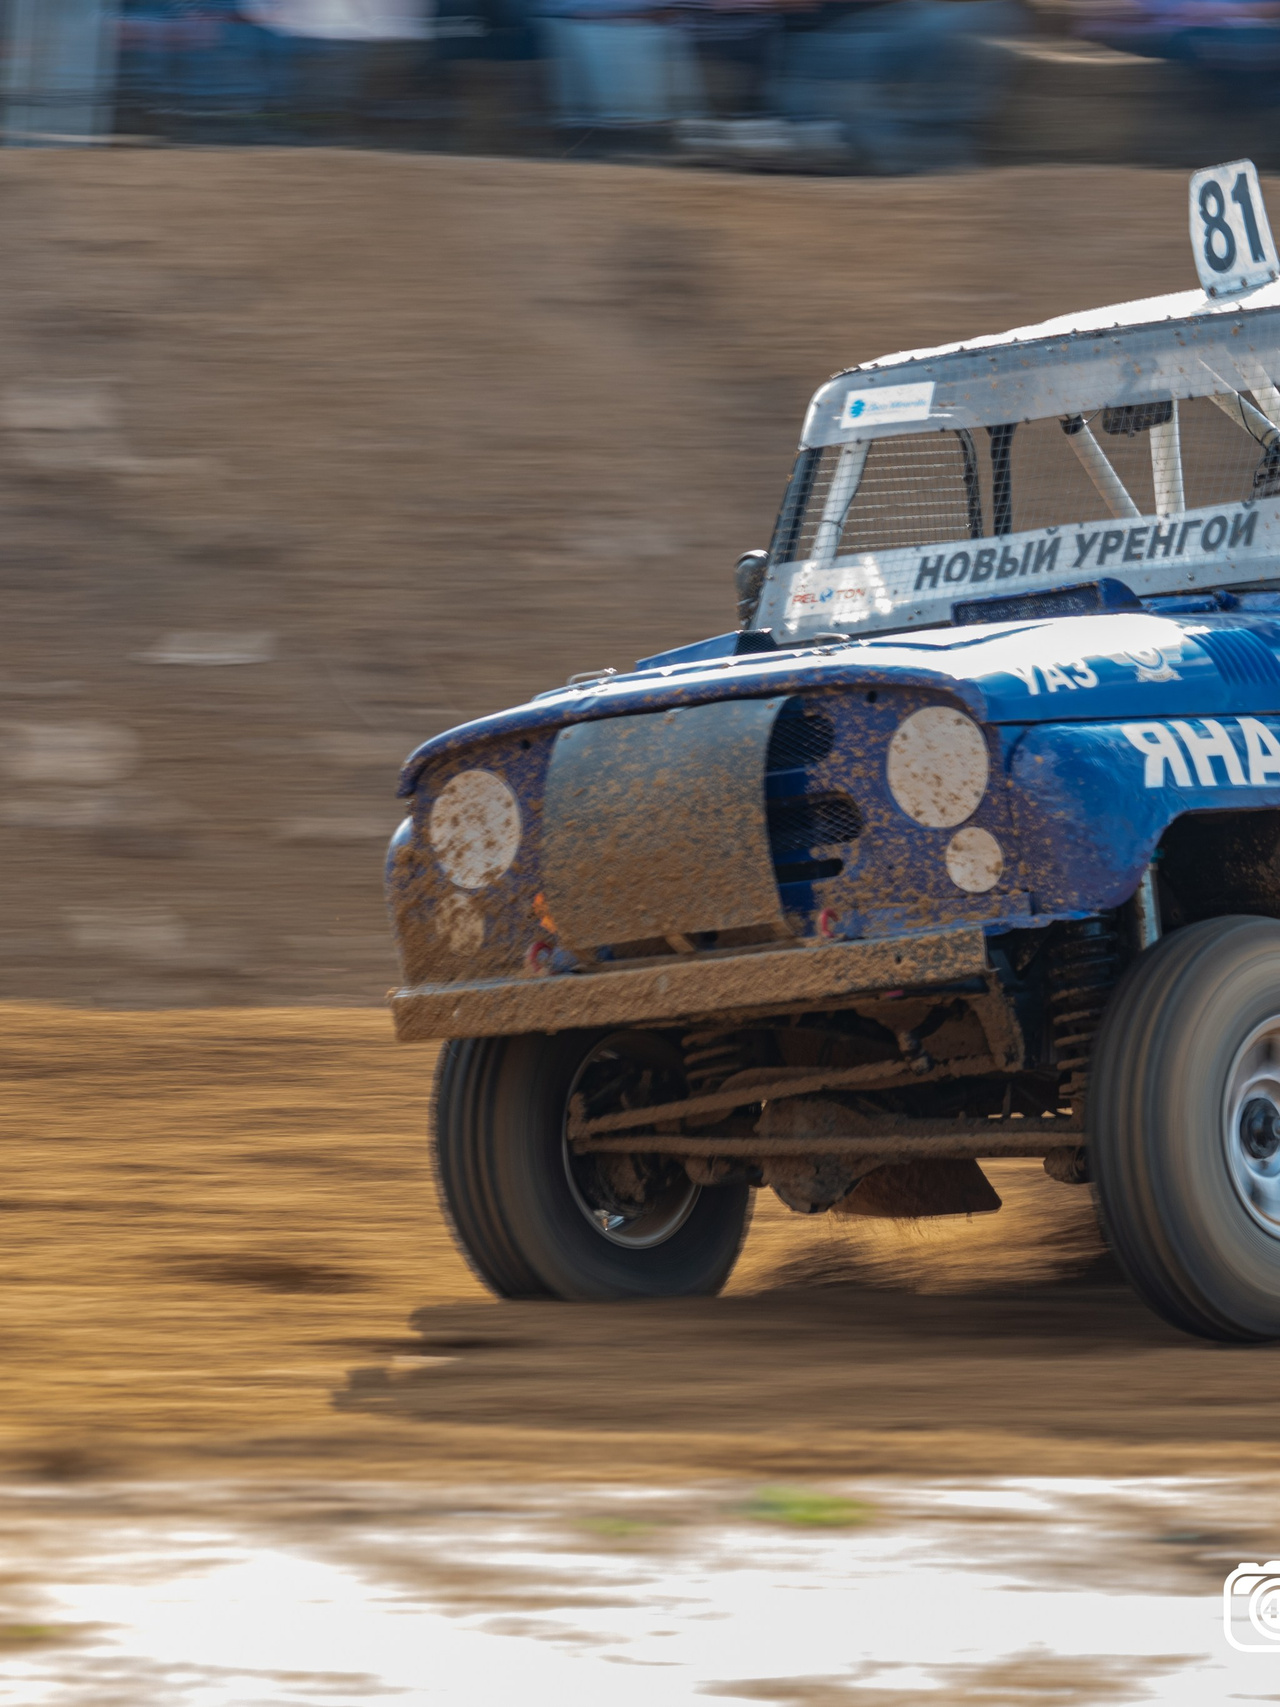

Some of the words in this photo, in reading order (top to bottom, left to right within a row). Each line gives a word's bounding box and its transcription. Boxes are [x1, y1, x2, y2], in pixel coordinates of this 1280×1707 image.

[1199, 172, 1266, 273] 81
[914, 527, 1061, 590] НОВЫЙ
[1073, 499, 1259, 568] УРЕНГОЙ
[1012, 660, 1101, 696] УАЗ
